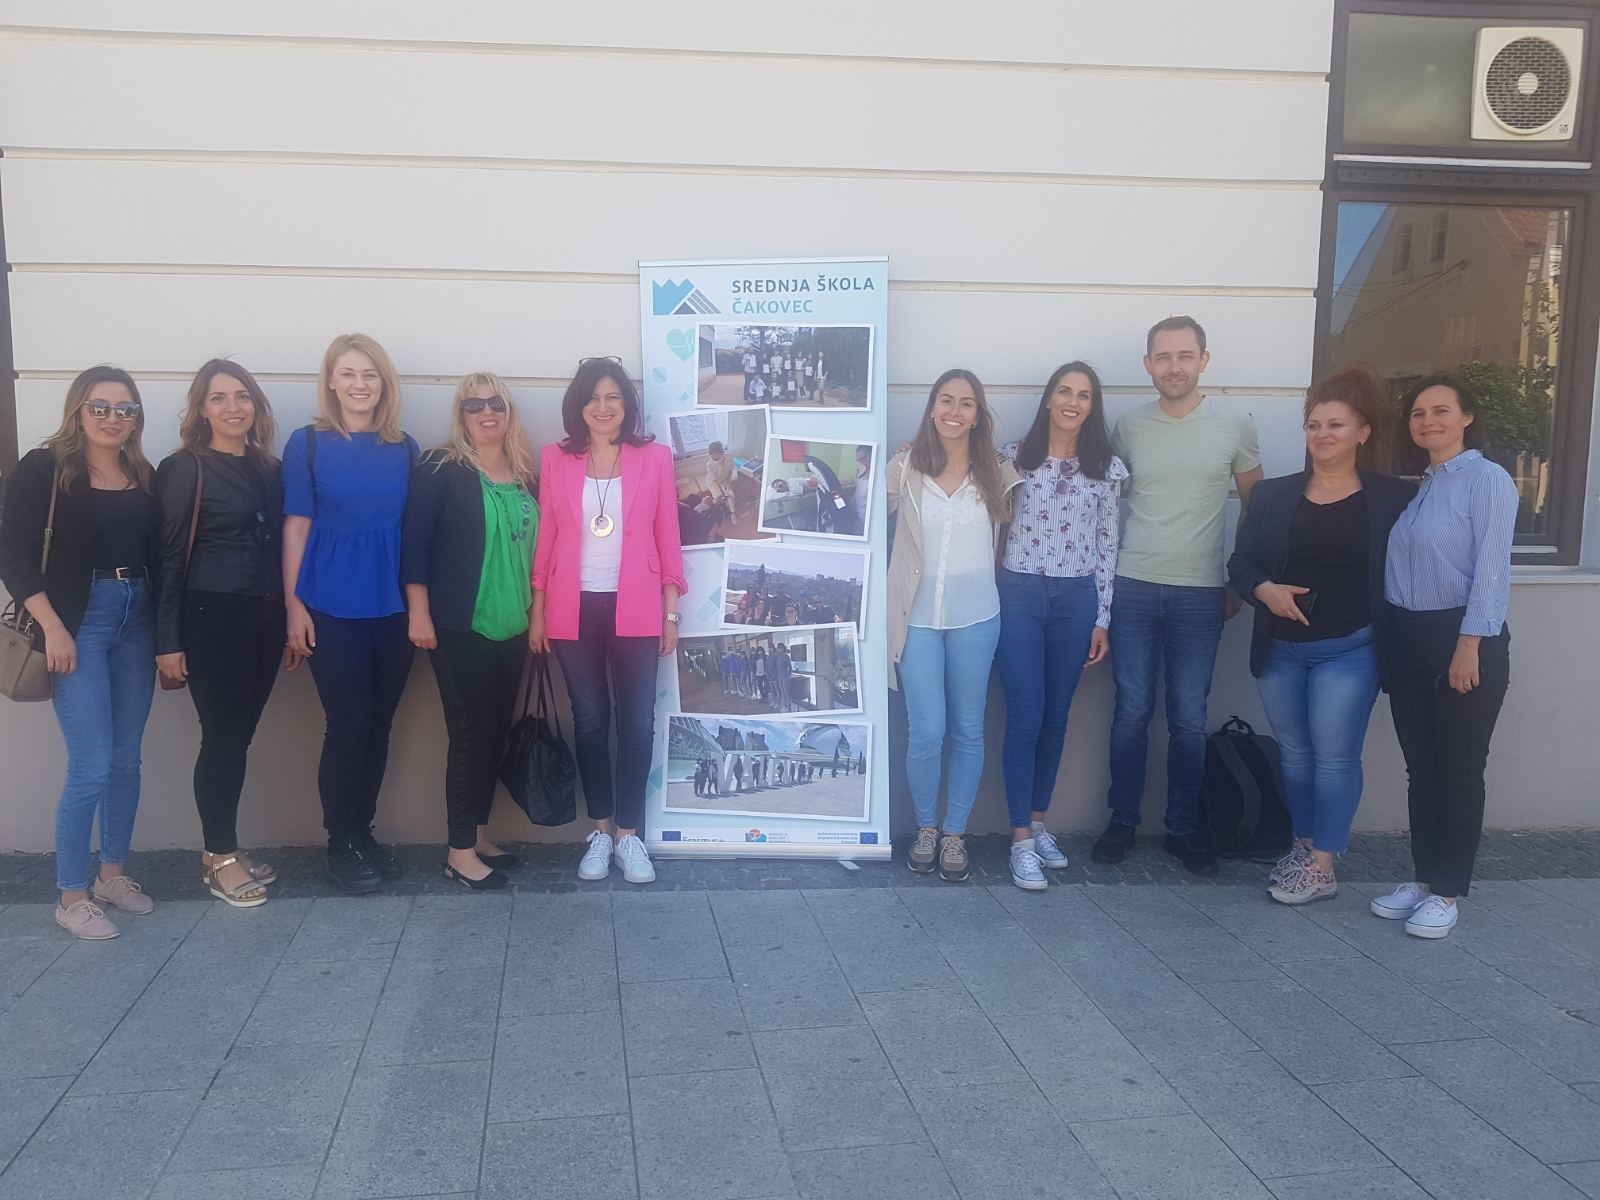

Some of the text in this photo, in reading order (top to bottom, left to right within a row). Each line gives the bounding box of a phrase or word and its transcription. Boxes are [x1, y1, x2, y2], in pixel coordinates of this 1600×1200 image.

[732, 274, 875, 294] SREDNJA ŠKOLA
[732, 297, 813, 315] ČAKOVEC
